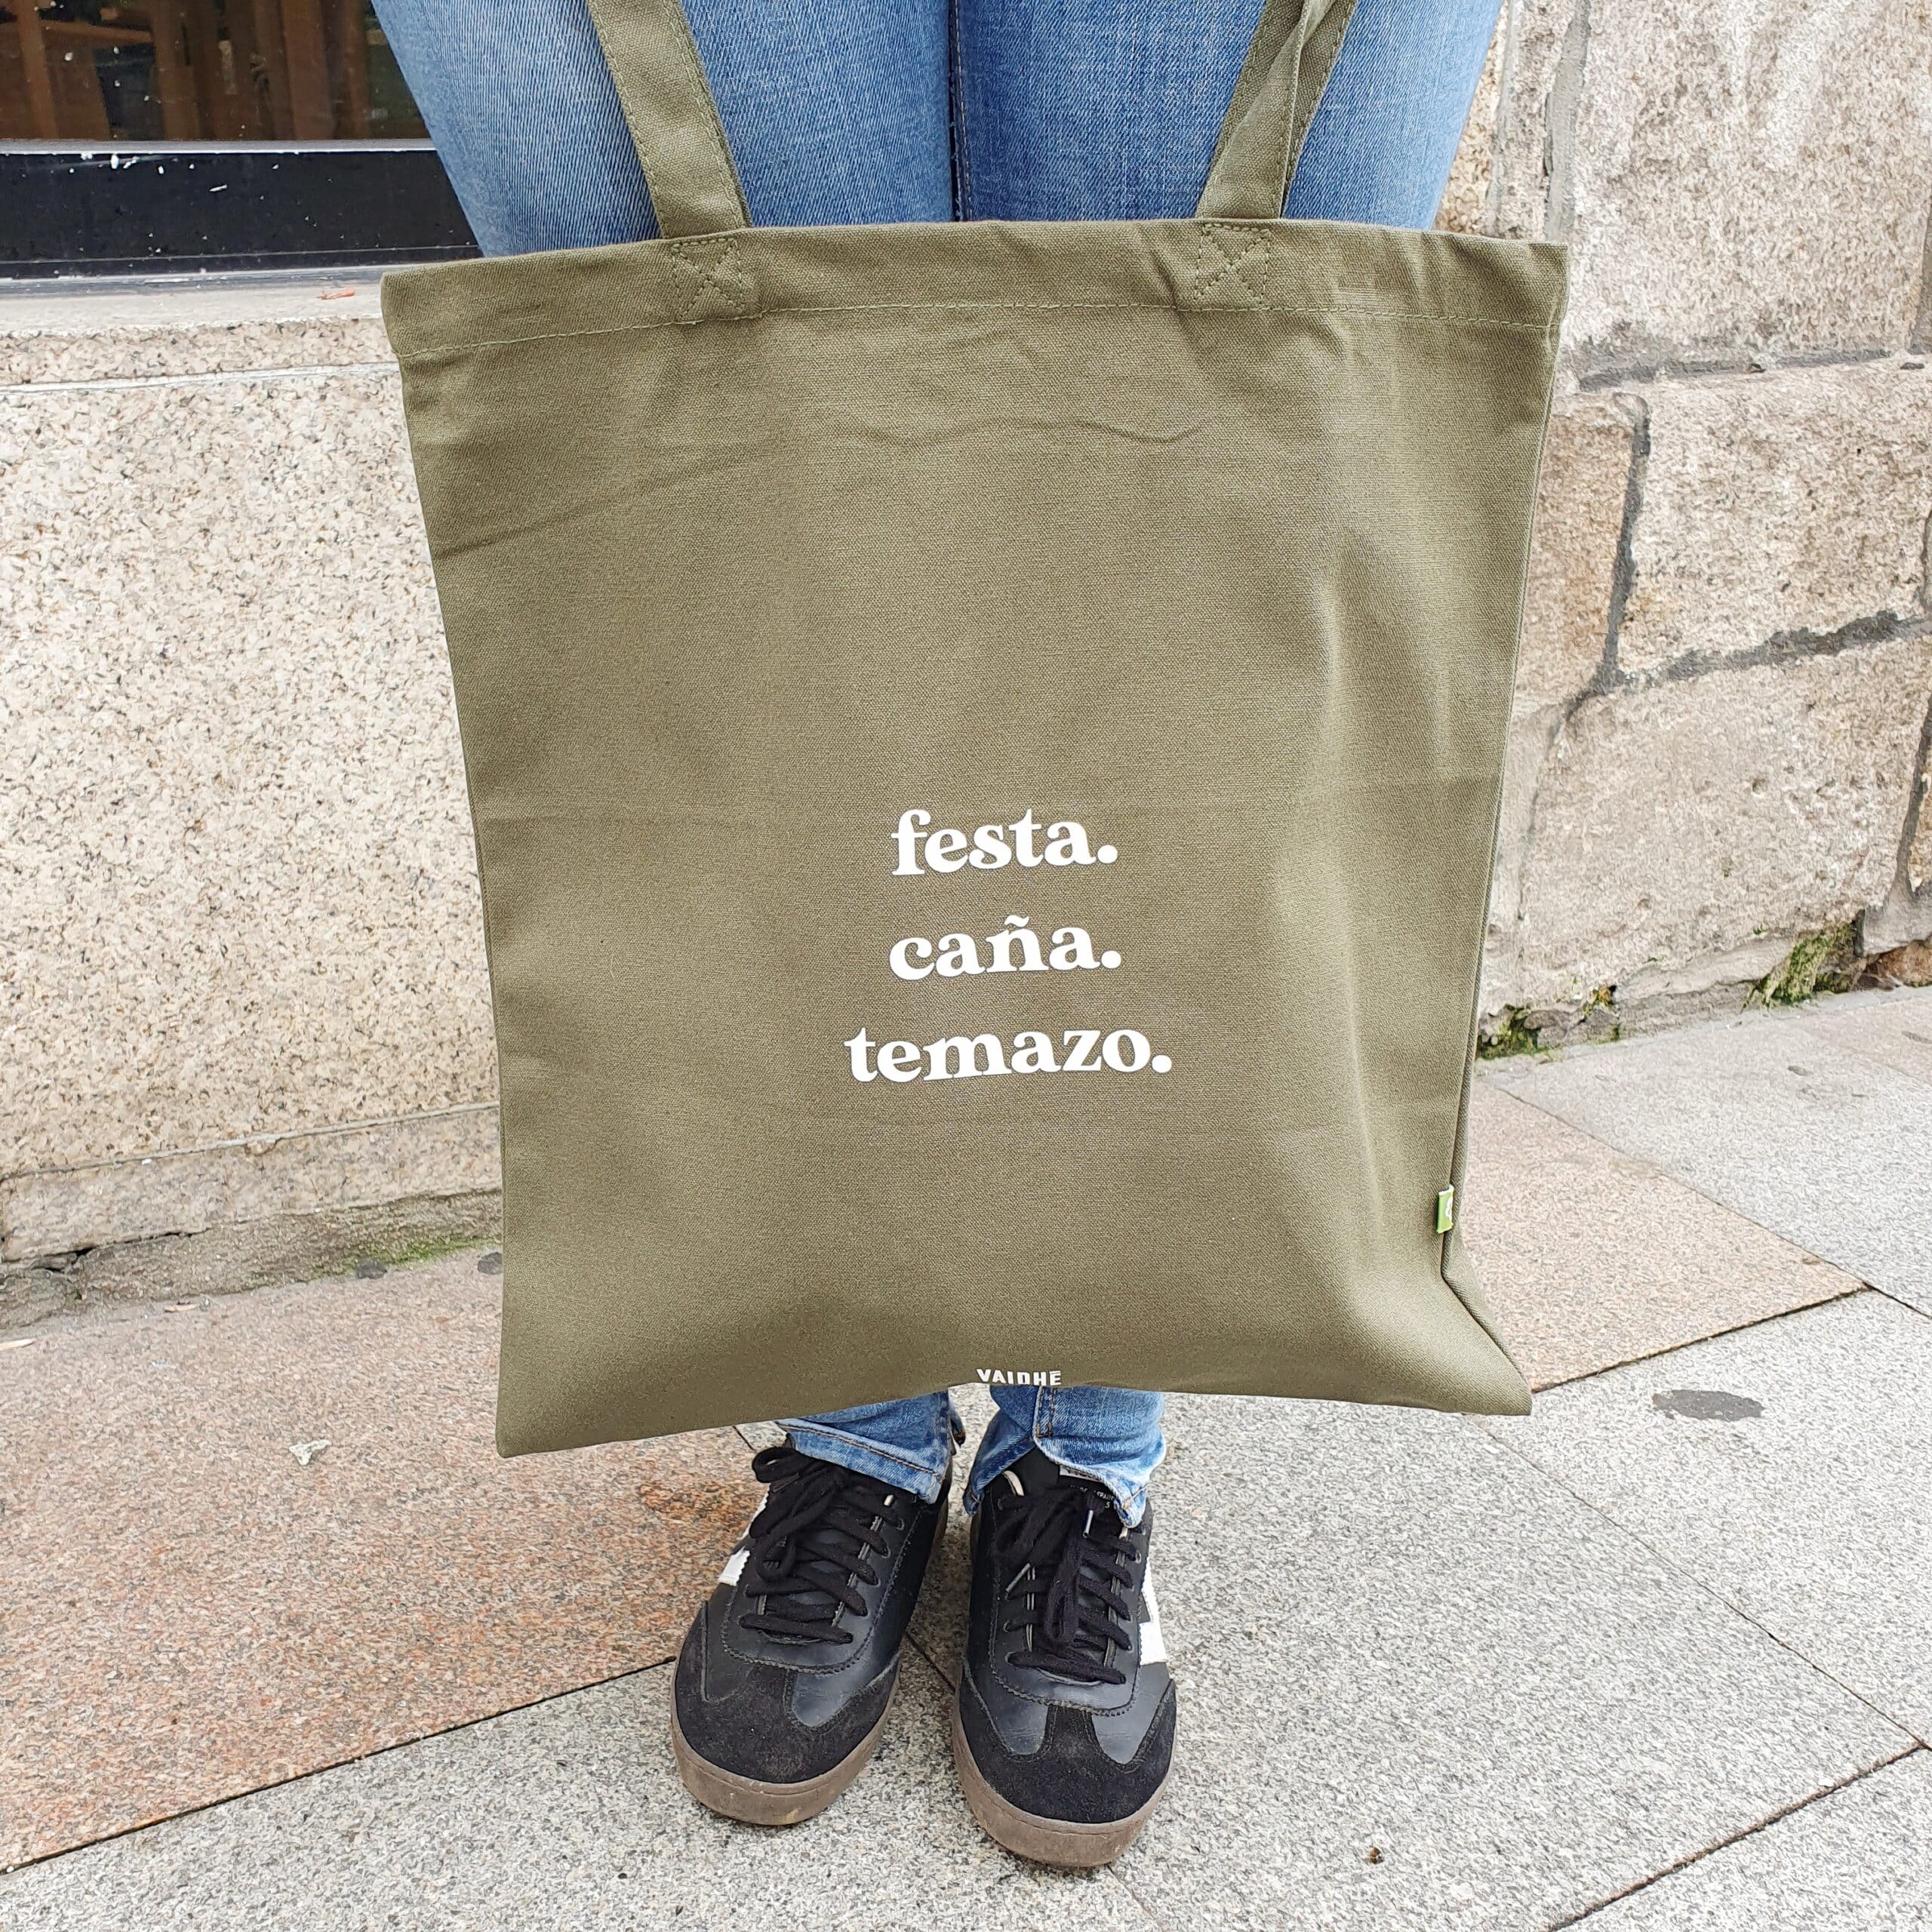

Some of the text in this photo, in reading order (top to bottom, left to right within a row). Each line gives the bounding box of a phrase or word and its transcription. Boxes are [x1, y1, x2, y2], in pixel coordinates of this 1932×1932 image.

[891, 808, 1118, 875] festa.
[889, 914, 1121, 980] caña.
[844, 1027, 1173, 1083] temazo.
[977, 1368, 1062, 1386] VAIDHE
